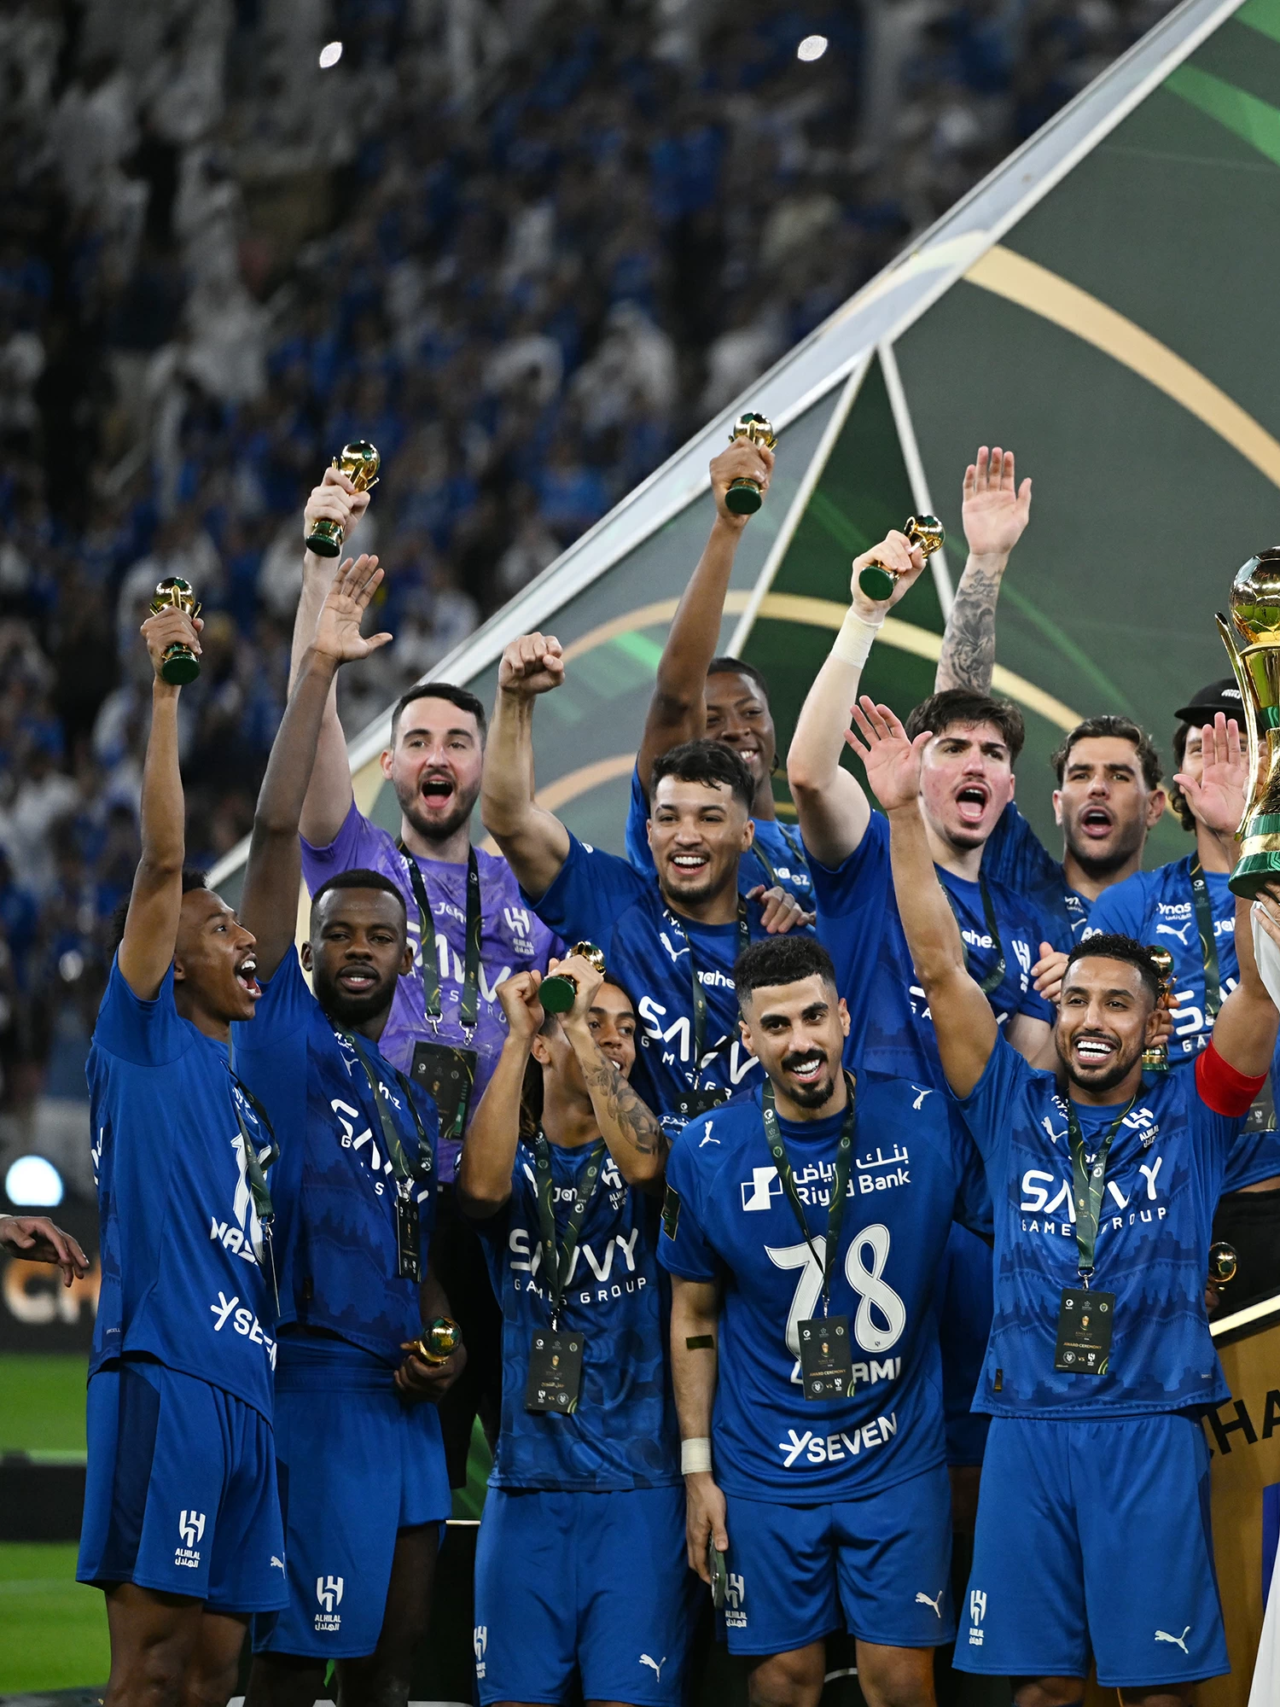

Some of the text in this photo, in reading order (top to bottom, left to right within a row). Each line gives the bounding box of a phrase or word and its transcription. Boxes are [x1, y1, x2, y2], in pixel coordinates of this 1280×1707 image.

[1157, 902, 1191, 914] ynas
[856, 1143, 909, 1169] بنك
[796, 1168, 911, 1207] Riyd Bank
[1020, 1157, 1162, 1223] SAVY
[1022, 1207, 1167, 1237] GAME ROUP
[580, 1277, 647, 1305] GROUP
[763, 1222, 907, 1361] 78
